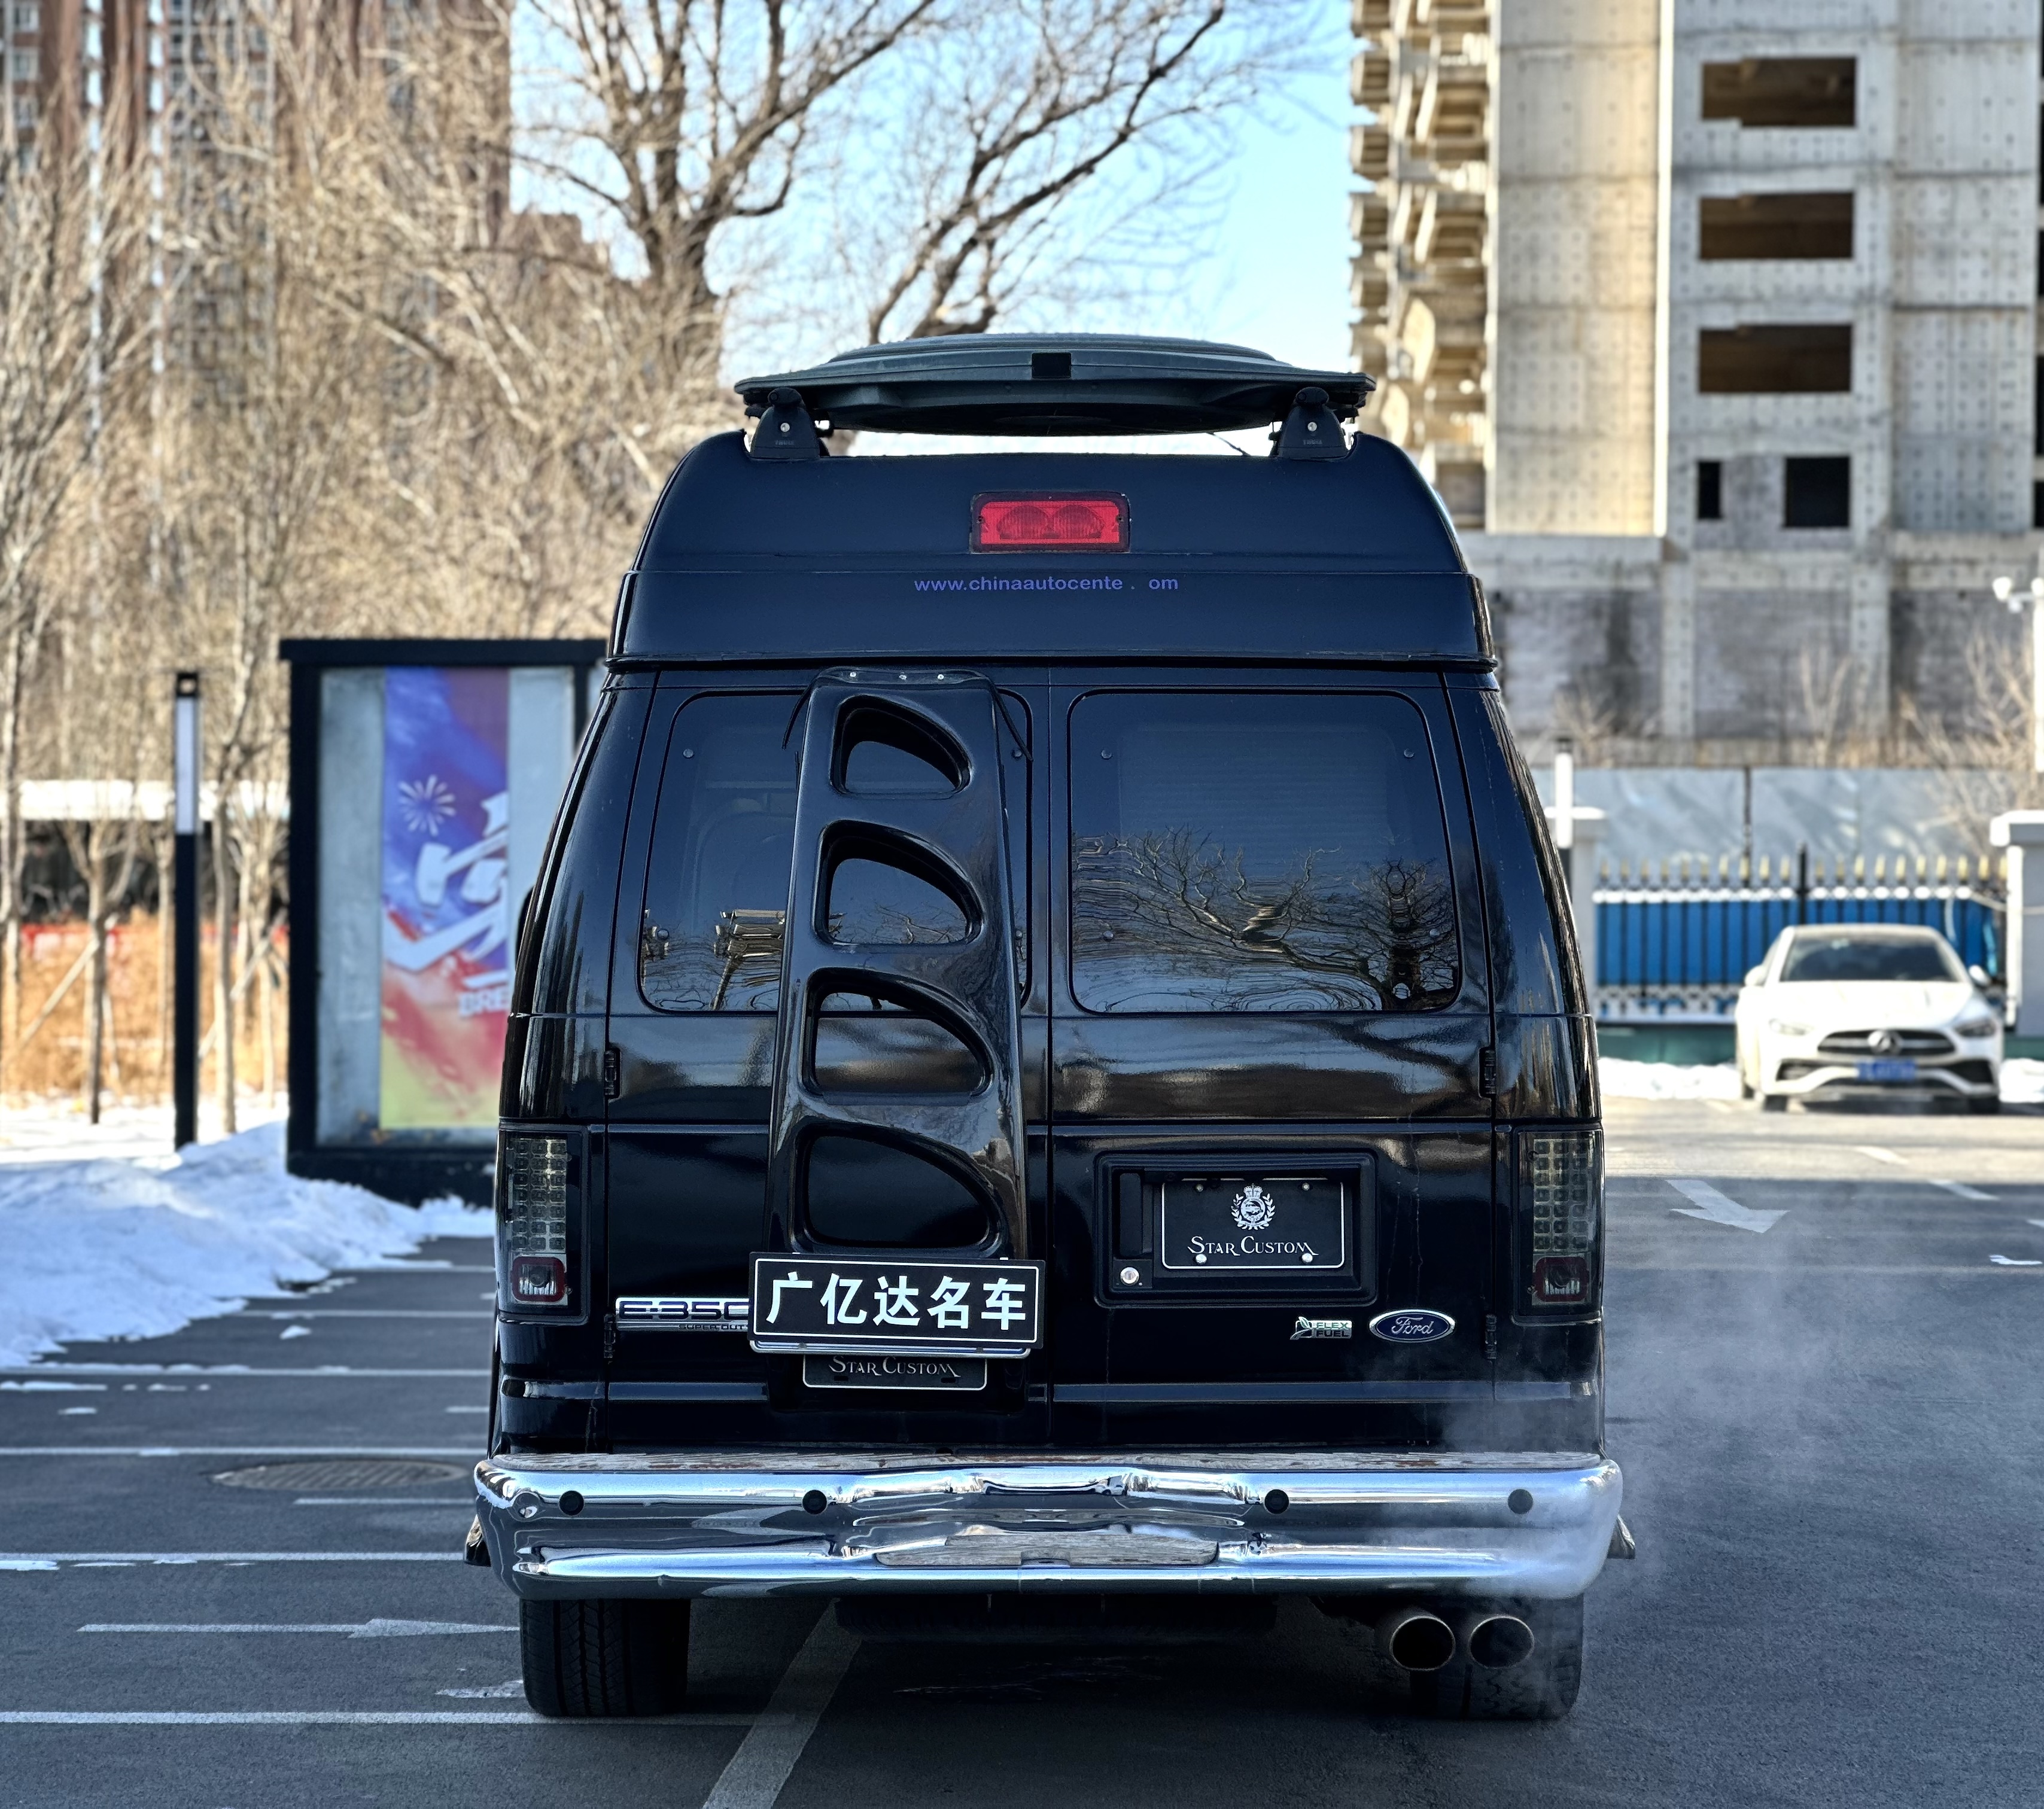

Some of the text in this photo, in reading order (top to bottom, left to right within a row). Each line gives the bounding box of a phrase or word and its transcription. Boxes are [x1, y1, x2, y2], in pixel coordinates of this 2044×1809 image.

[1187, 1235, 1319, 1256] STAR CUSTOM
[766, 1271, 1026, 1331] 广亿达名车
[1391, 1316, 1434, 1335] Ford
